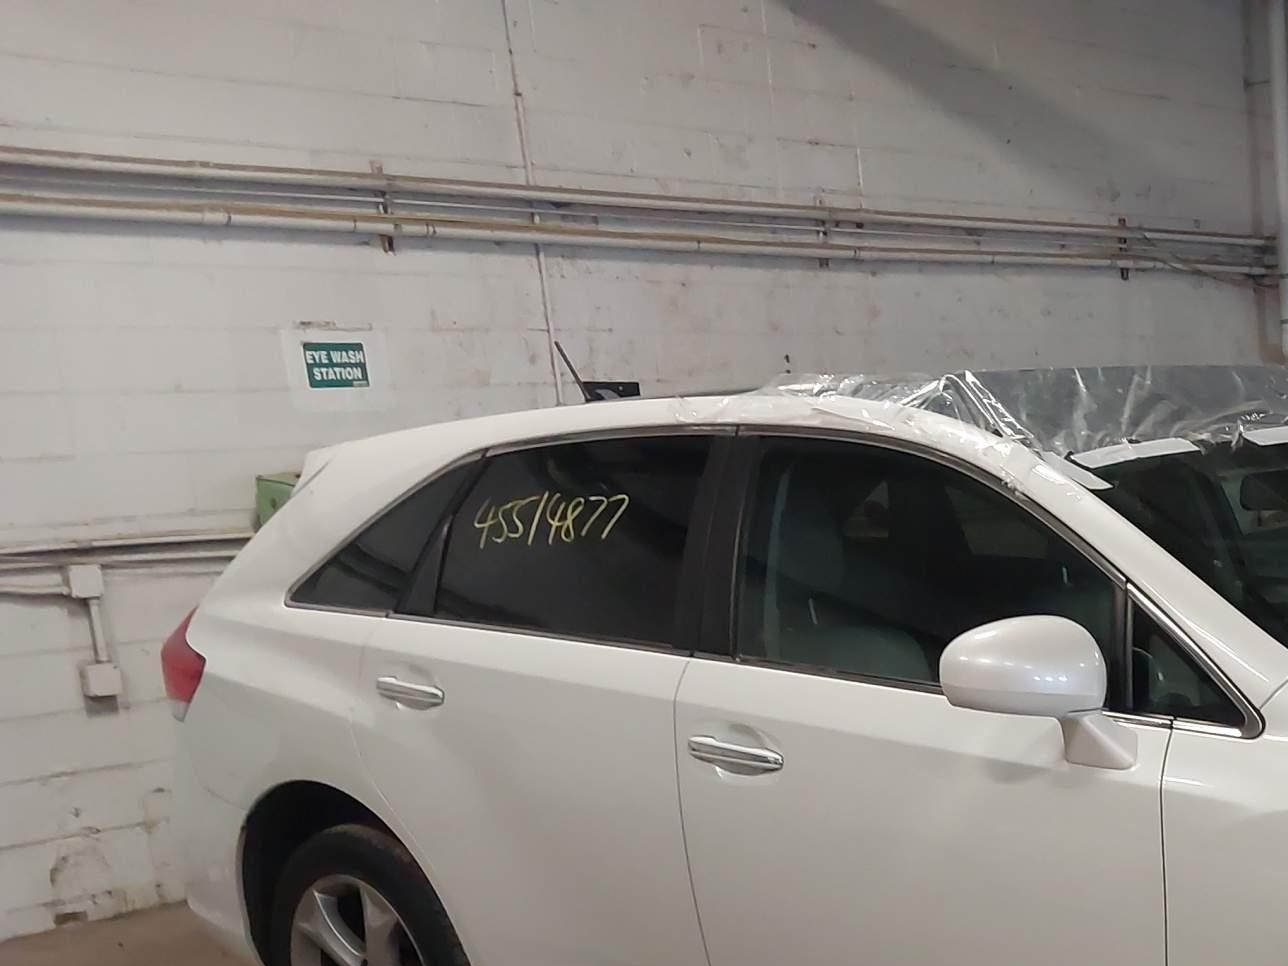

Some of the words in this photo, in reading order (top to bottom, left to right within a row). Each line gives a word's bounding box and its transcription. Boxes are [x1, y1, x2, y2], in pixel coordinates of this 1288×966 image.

[305, 350, 329, 364] EYE
[329, 350, 365, 363] WASH
[313, 367, 362, 380] STATION
[473, 490, 630, 549] 45514877
